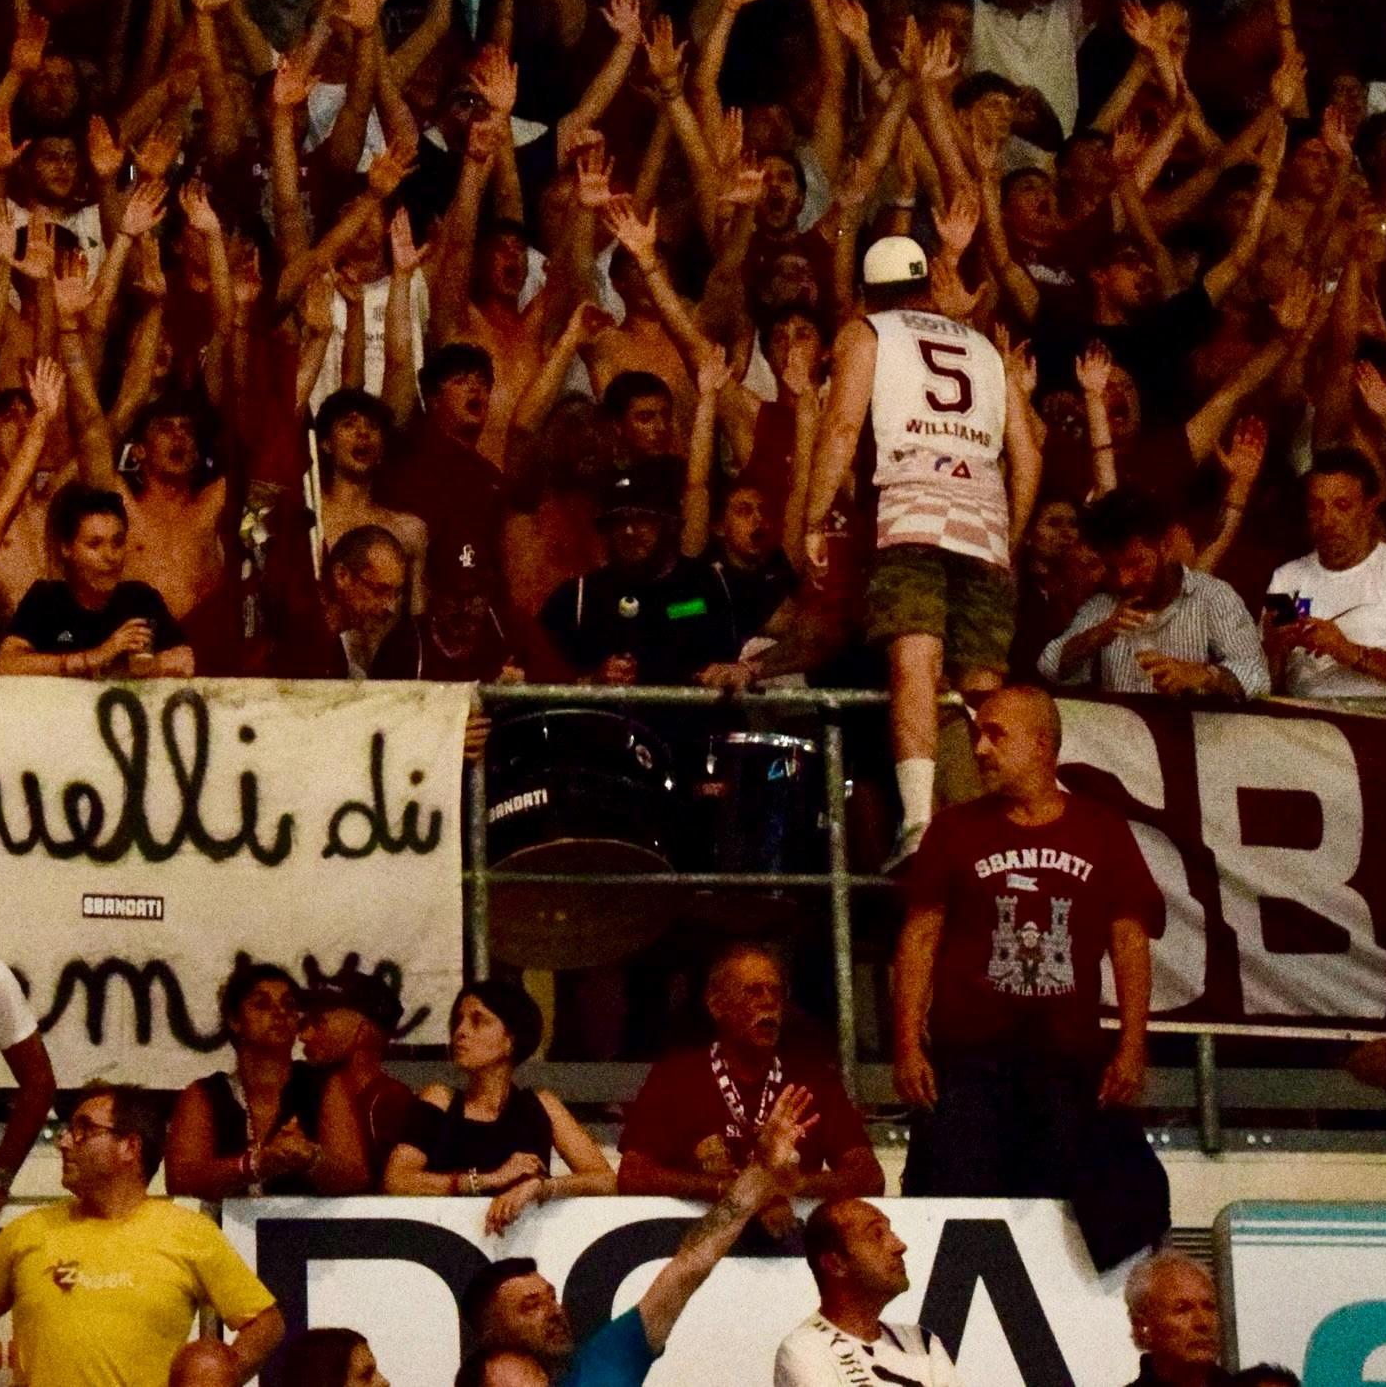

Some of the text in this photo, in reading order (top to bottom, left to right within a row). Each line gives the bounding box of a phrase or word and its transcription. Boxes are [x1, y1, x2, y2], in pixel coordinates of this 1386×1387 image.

[917, 339, 973, 414] 5
[906, 418, 991, 448] WILLIAMS
[322, 731, 443, 861] di
[488, 787, 548, 823] BANDATI
[973, 847, 1094, 884] SBANDATI
[83, 895, 162, 918] SBANDATI
